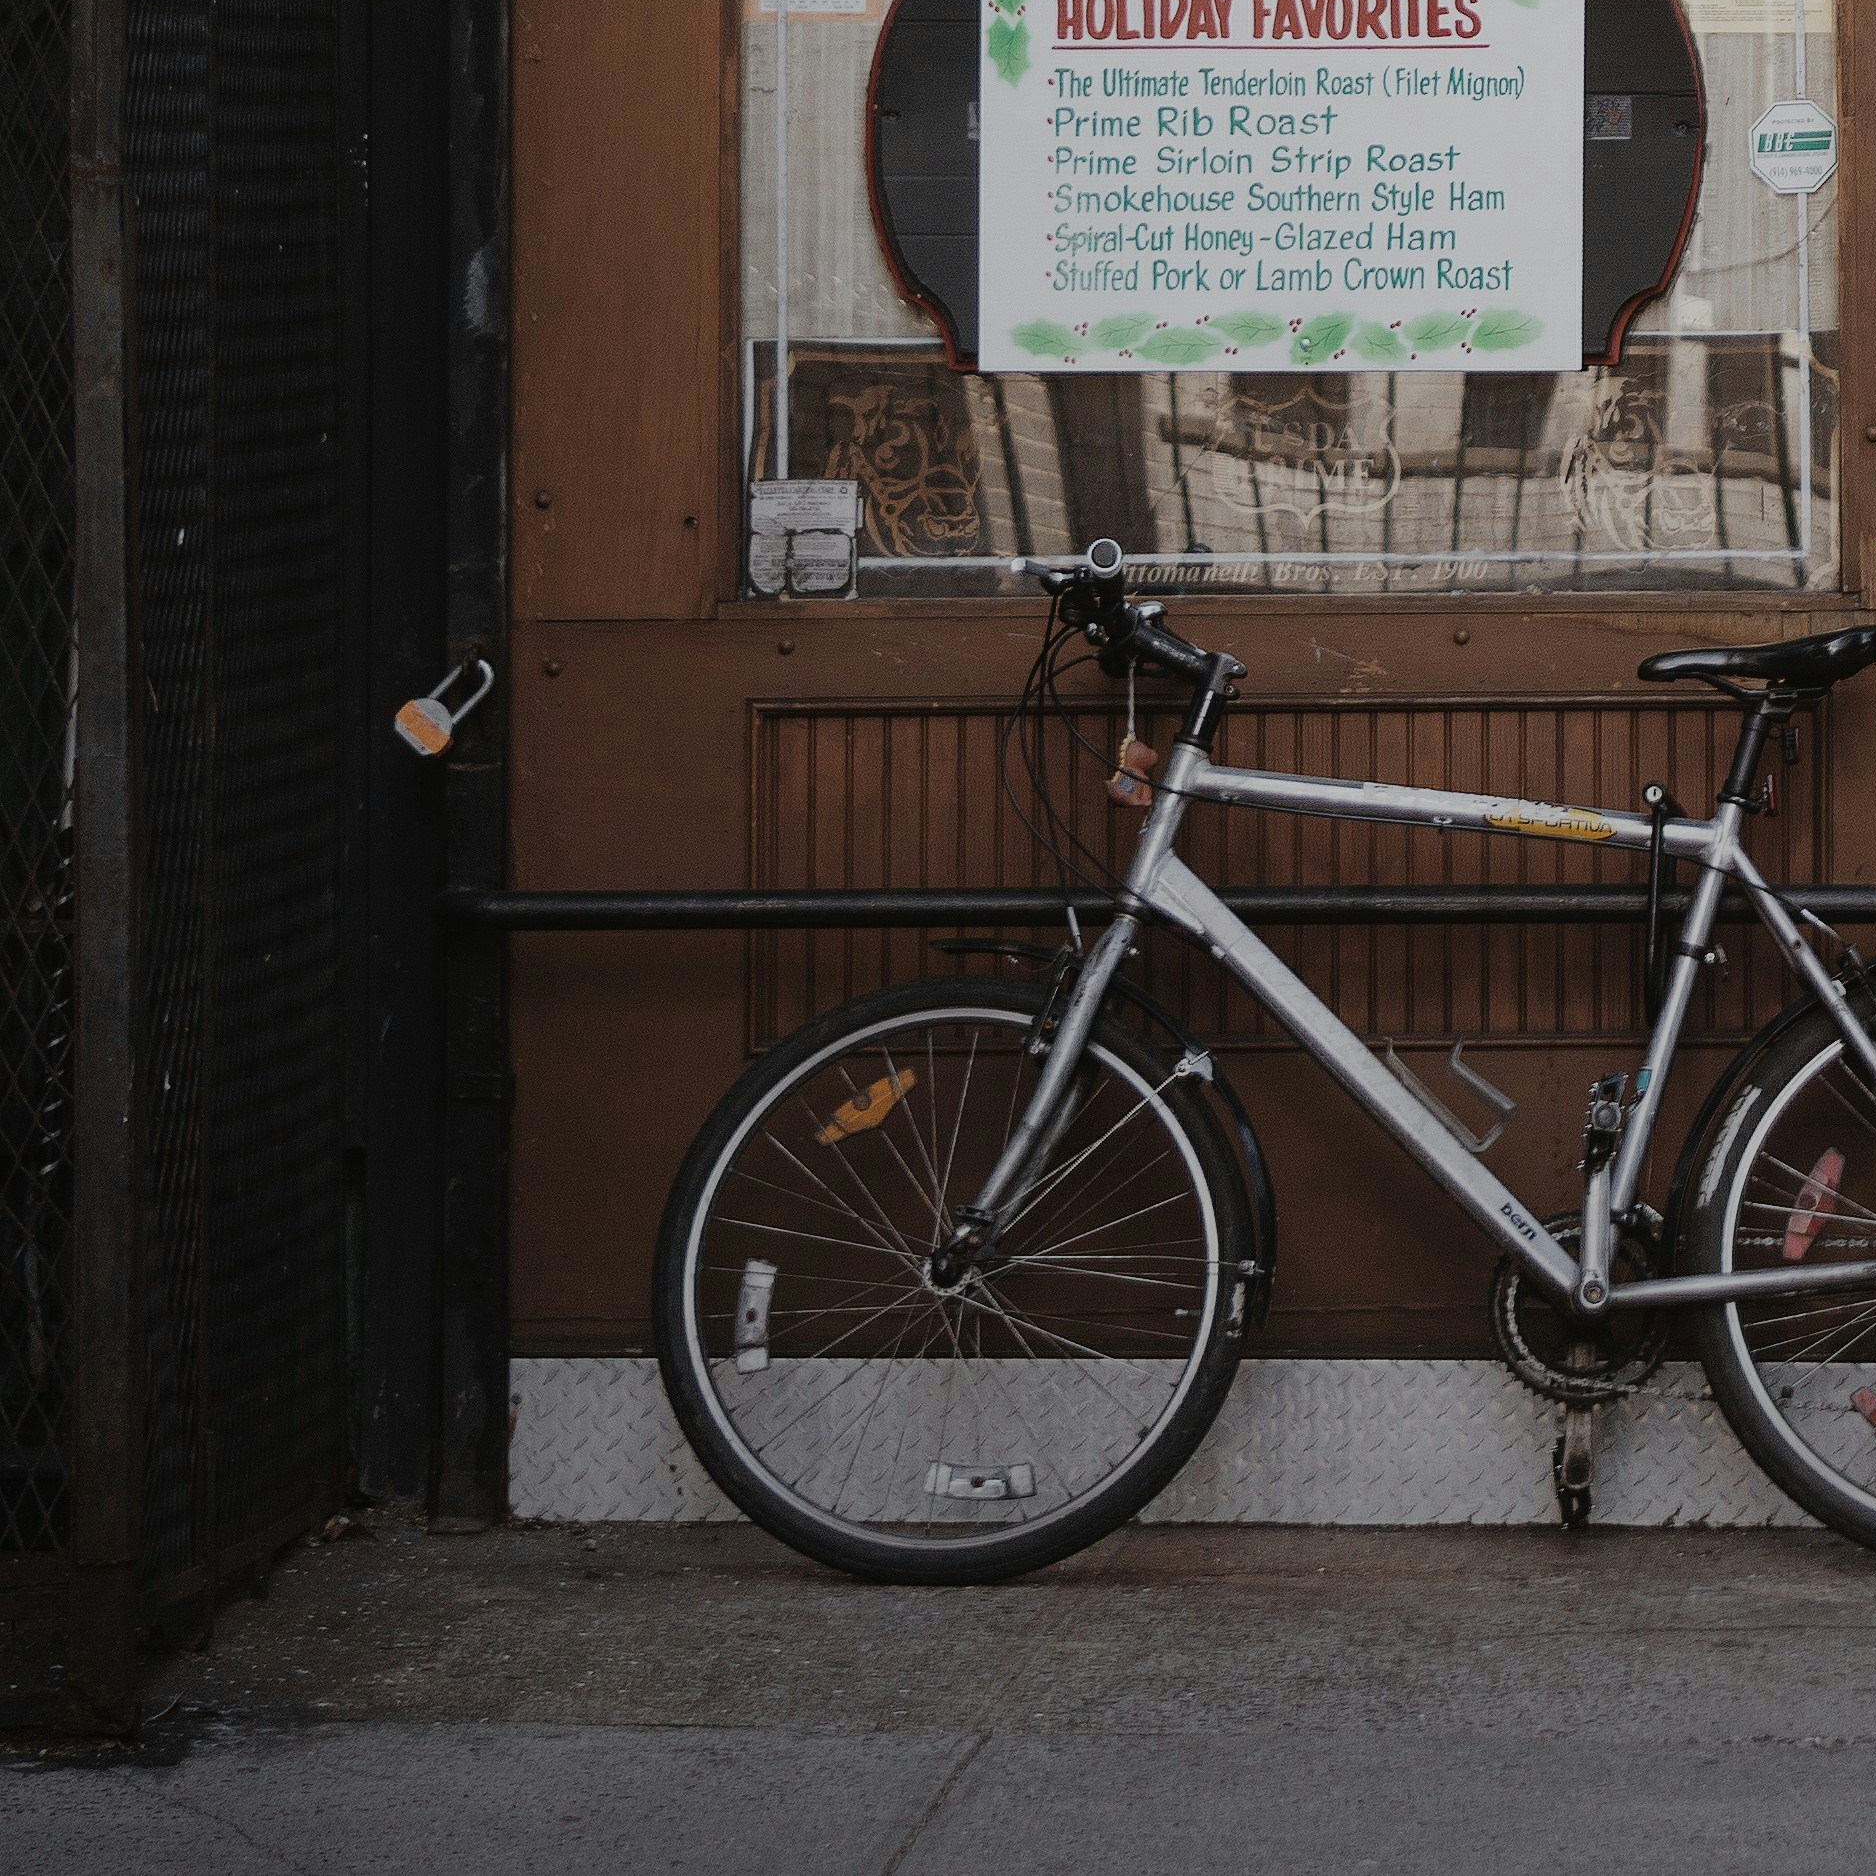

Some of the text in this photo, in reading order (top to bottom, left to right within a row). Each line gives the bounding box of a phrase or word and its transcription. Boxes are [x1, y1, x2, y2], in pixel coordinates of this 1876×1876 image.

[1054, 65, 1525, 101] The Ultimate Tenderloin Roast (Filet Mignon)
[1055, 105, 1338, 137] Prime Rib Roast
[1055, 144, 1461, 179] Prime Sirloin Strip Roast
[1054, 181, 1505, 216] Smokehouse Southern Style Ham
[1055, 222, 1174, 257] Spiral-Cut
[1387, 221, 1456, 251] Ham
[1053, 257, 1513, 291] Stuffed Pork or Lamb Crown Roast
[1232, 459, 1377, 491] RIME
[1122, 560, 1259, 585] ttomanelli
[1274, 561, 1340, 584] Bros.
[1432, 559, 1490, 582] 1900
[1500, 1202, 1536, 1241] bern
